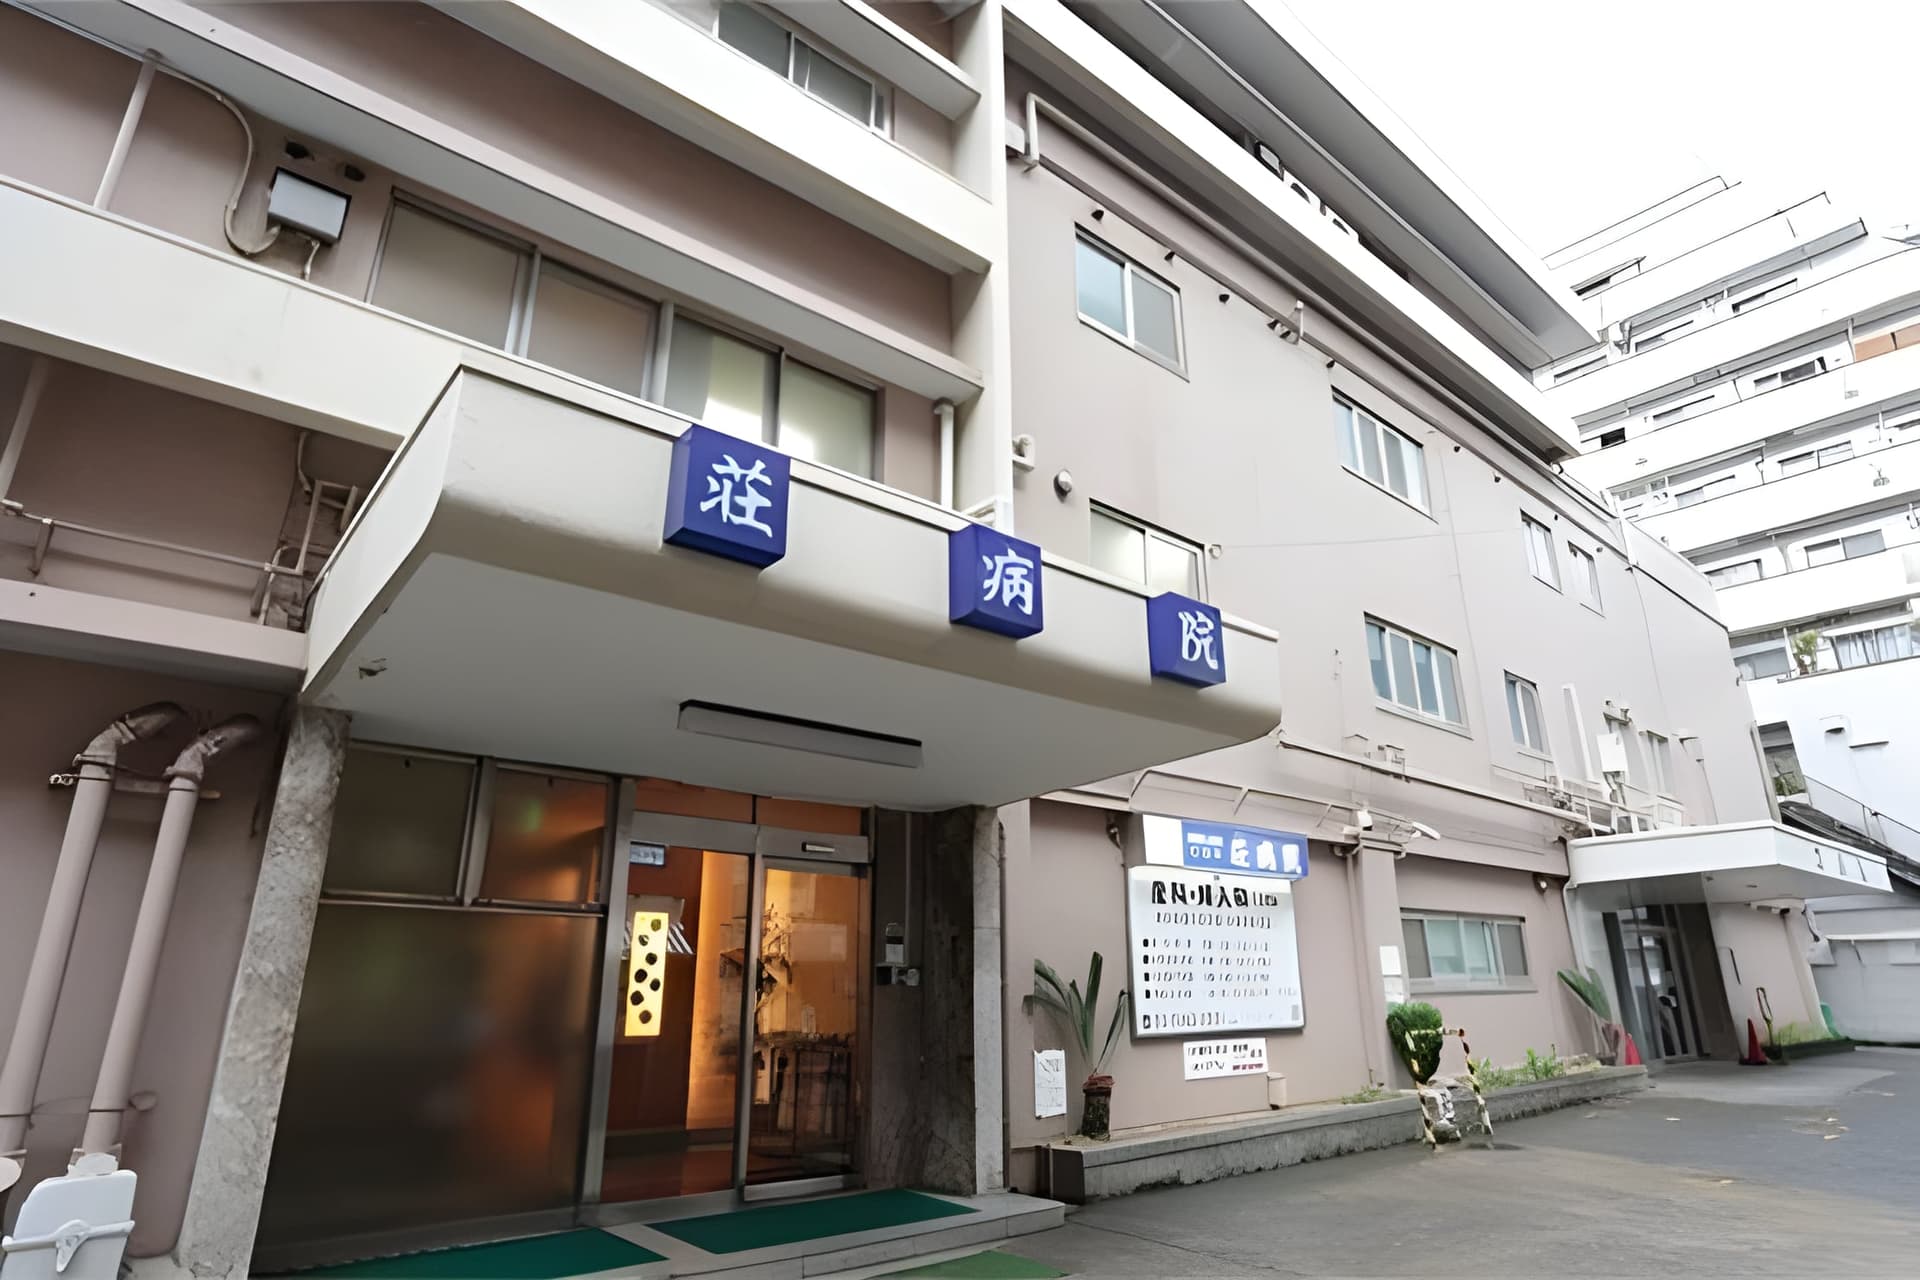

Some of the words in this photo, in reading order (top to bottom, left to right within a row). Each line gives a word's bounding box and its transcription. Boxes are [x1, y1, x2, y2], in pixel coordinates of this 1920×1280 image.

[700, 455, 772, 537] 荘
[983, 548, 1033, 614] 病
[1178, 611, 1218, 670] 院
